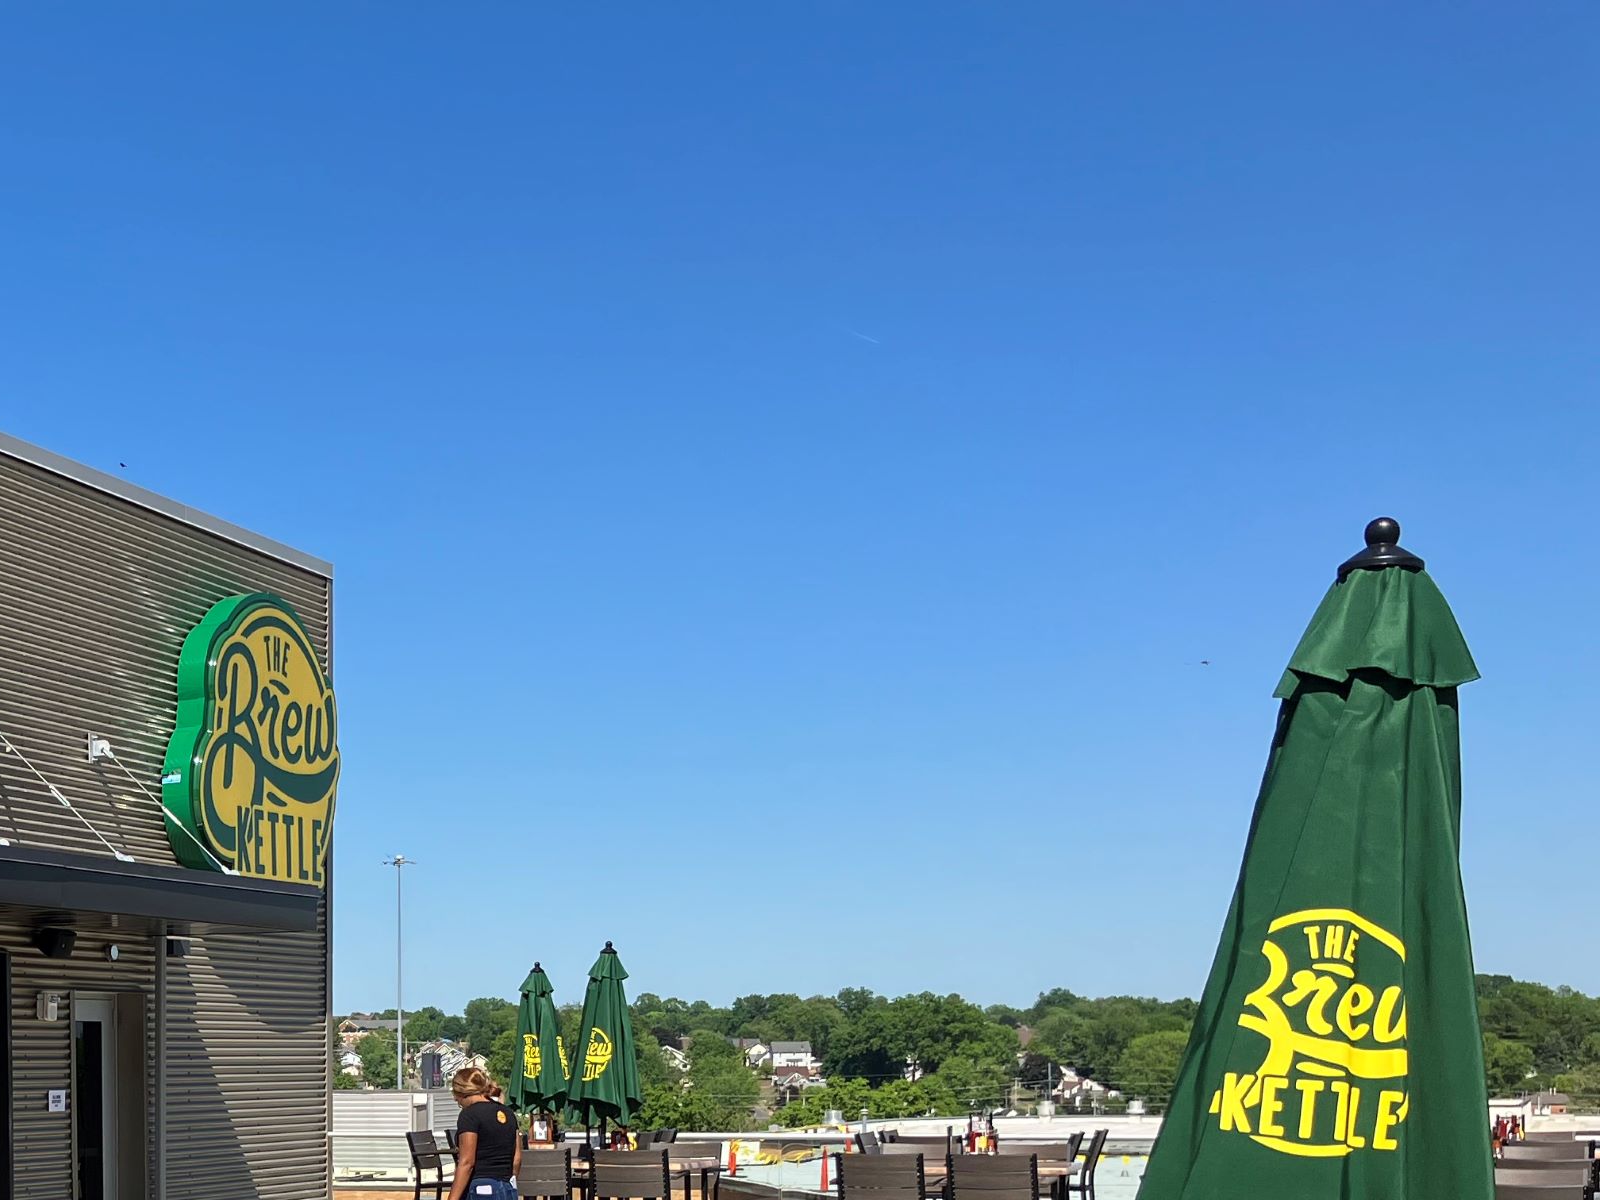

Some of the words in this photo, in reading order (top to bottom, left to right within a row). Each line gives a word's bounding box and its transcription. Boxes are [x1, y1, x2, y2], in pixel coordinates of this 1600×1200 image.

[263, 635, 290, 679] THE
[217, 641, 334, 790] Brew
[236, 804, 323, 883] KETTLE
[1303, 925, 1359, 964] THE
[1218, 1073, 1403, 1151] KETTLE
